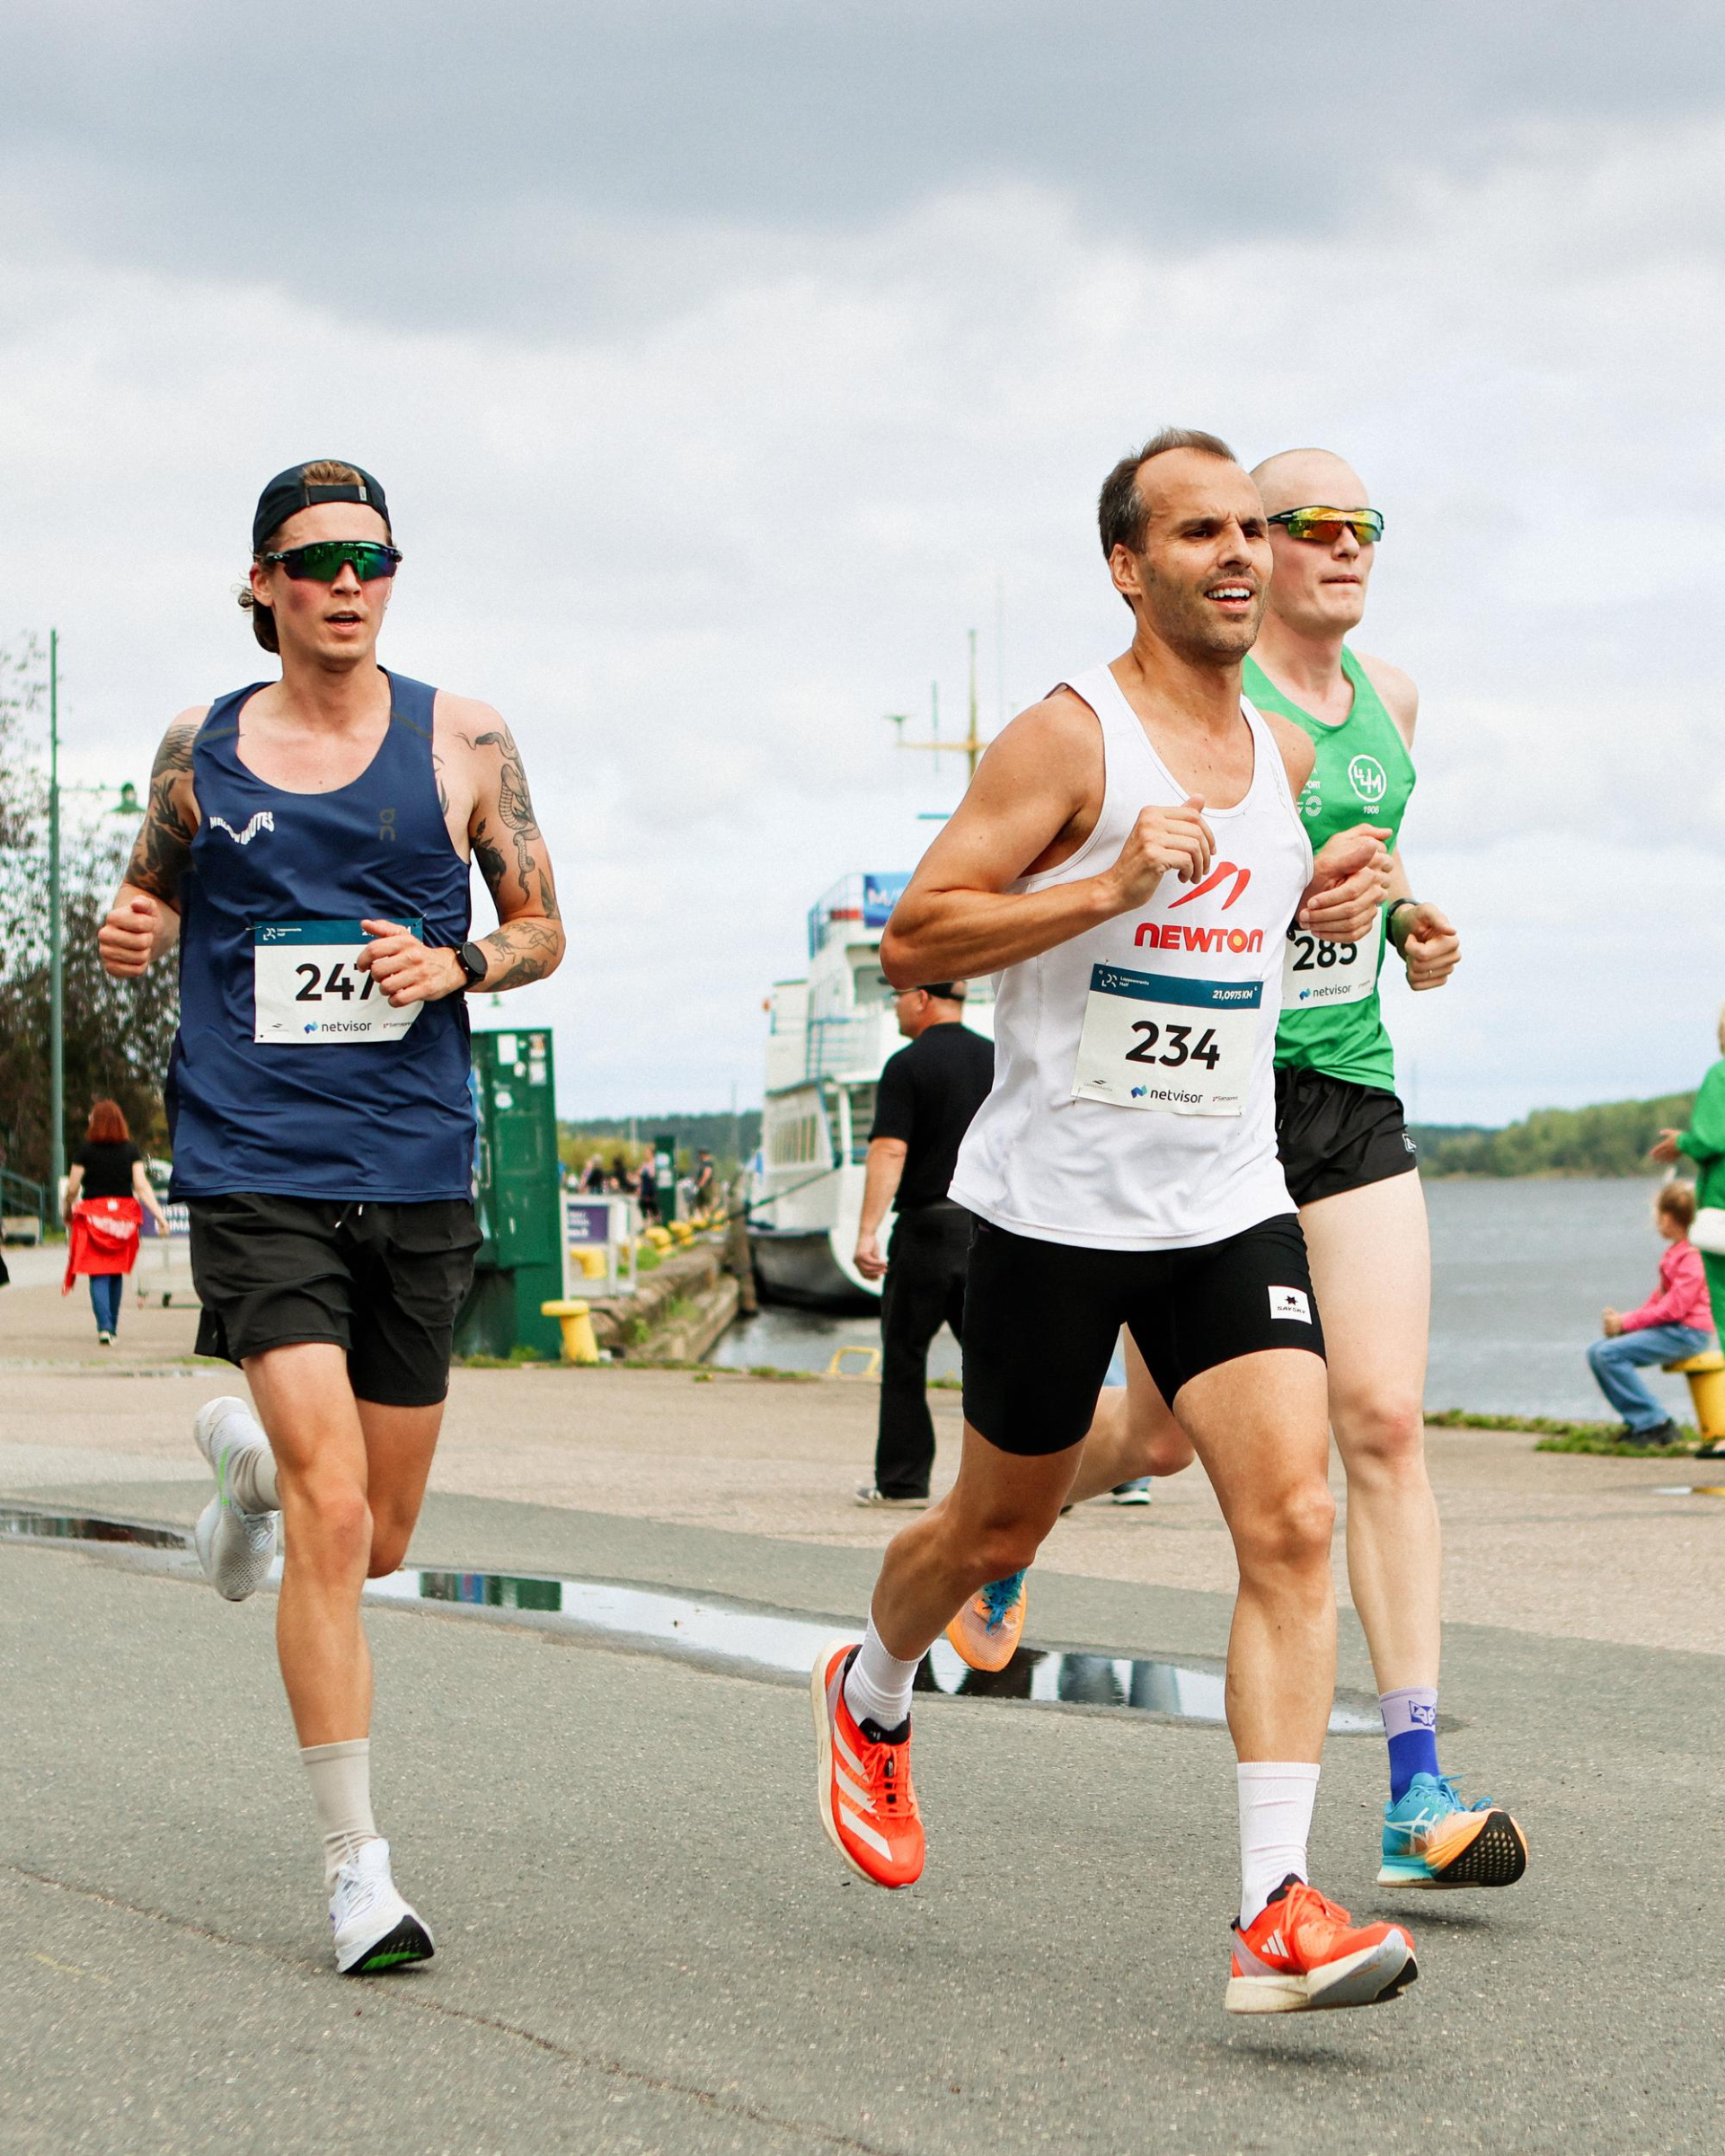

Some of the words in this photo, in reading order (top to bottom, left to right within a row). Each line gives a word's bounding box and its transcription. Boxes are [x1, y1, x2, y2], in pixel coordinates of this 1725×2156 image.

[1363, 805, 1380, 815] 1906
[1134, 922, 1264, 953] NEWTON
[1293, 935, 1358, 971] 285
[1313, 985, 1352, 997] netvisor
[321, 1021, 372, 1032] netvisor
[1125, 1020, 1220, 1070] 234
[1150, 1088, 1203, 1103] netvisor
